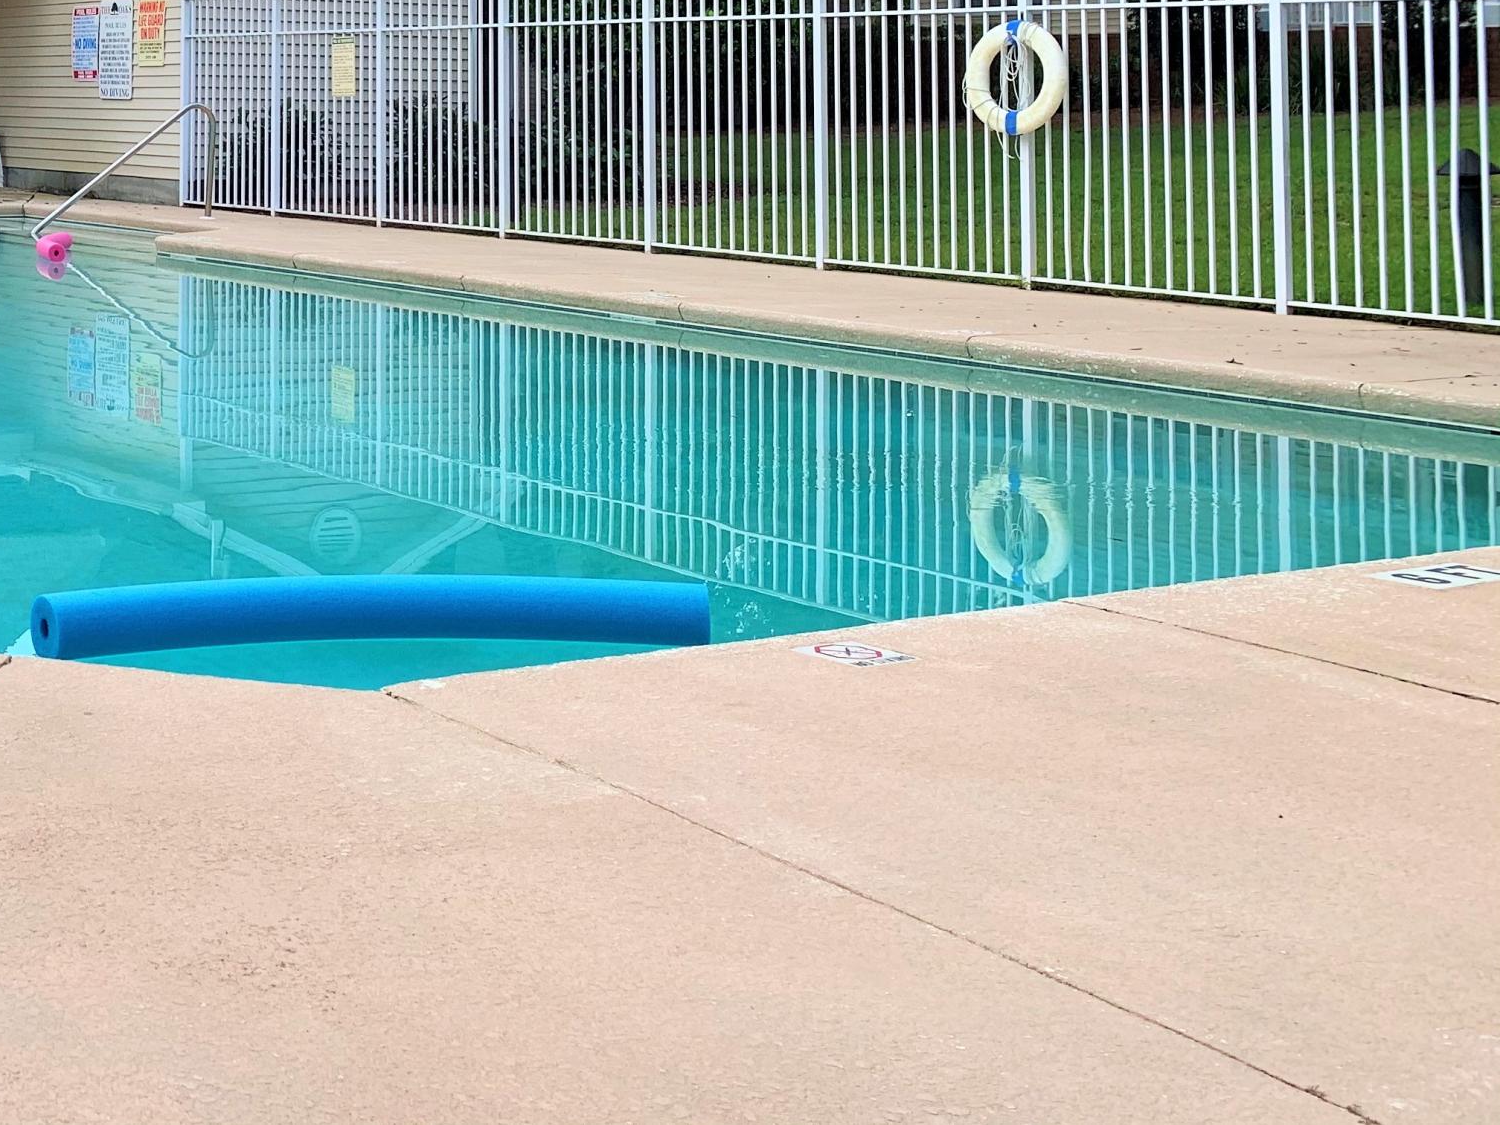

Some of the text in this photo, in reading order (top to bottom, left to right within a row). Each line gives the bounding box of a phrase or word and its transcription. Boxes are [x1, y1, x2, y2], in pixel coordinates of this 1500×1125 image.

[139, 15, 147, 26] LIFE
[148, 14, 163, 26] GUARD
[148, 27, 160, 39] DUTY
[100, 88, 129, 98] NO DIVING
[1390, 573, 1452, 584] 6
